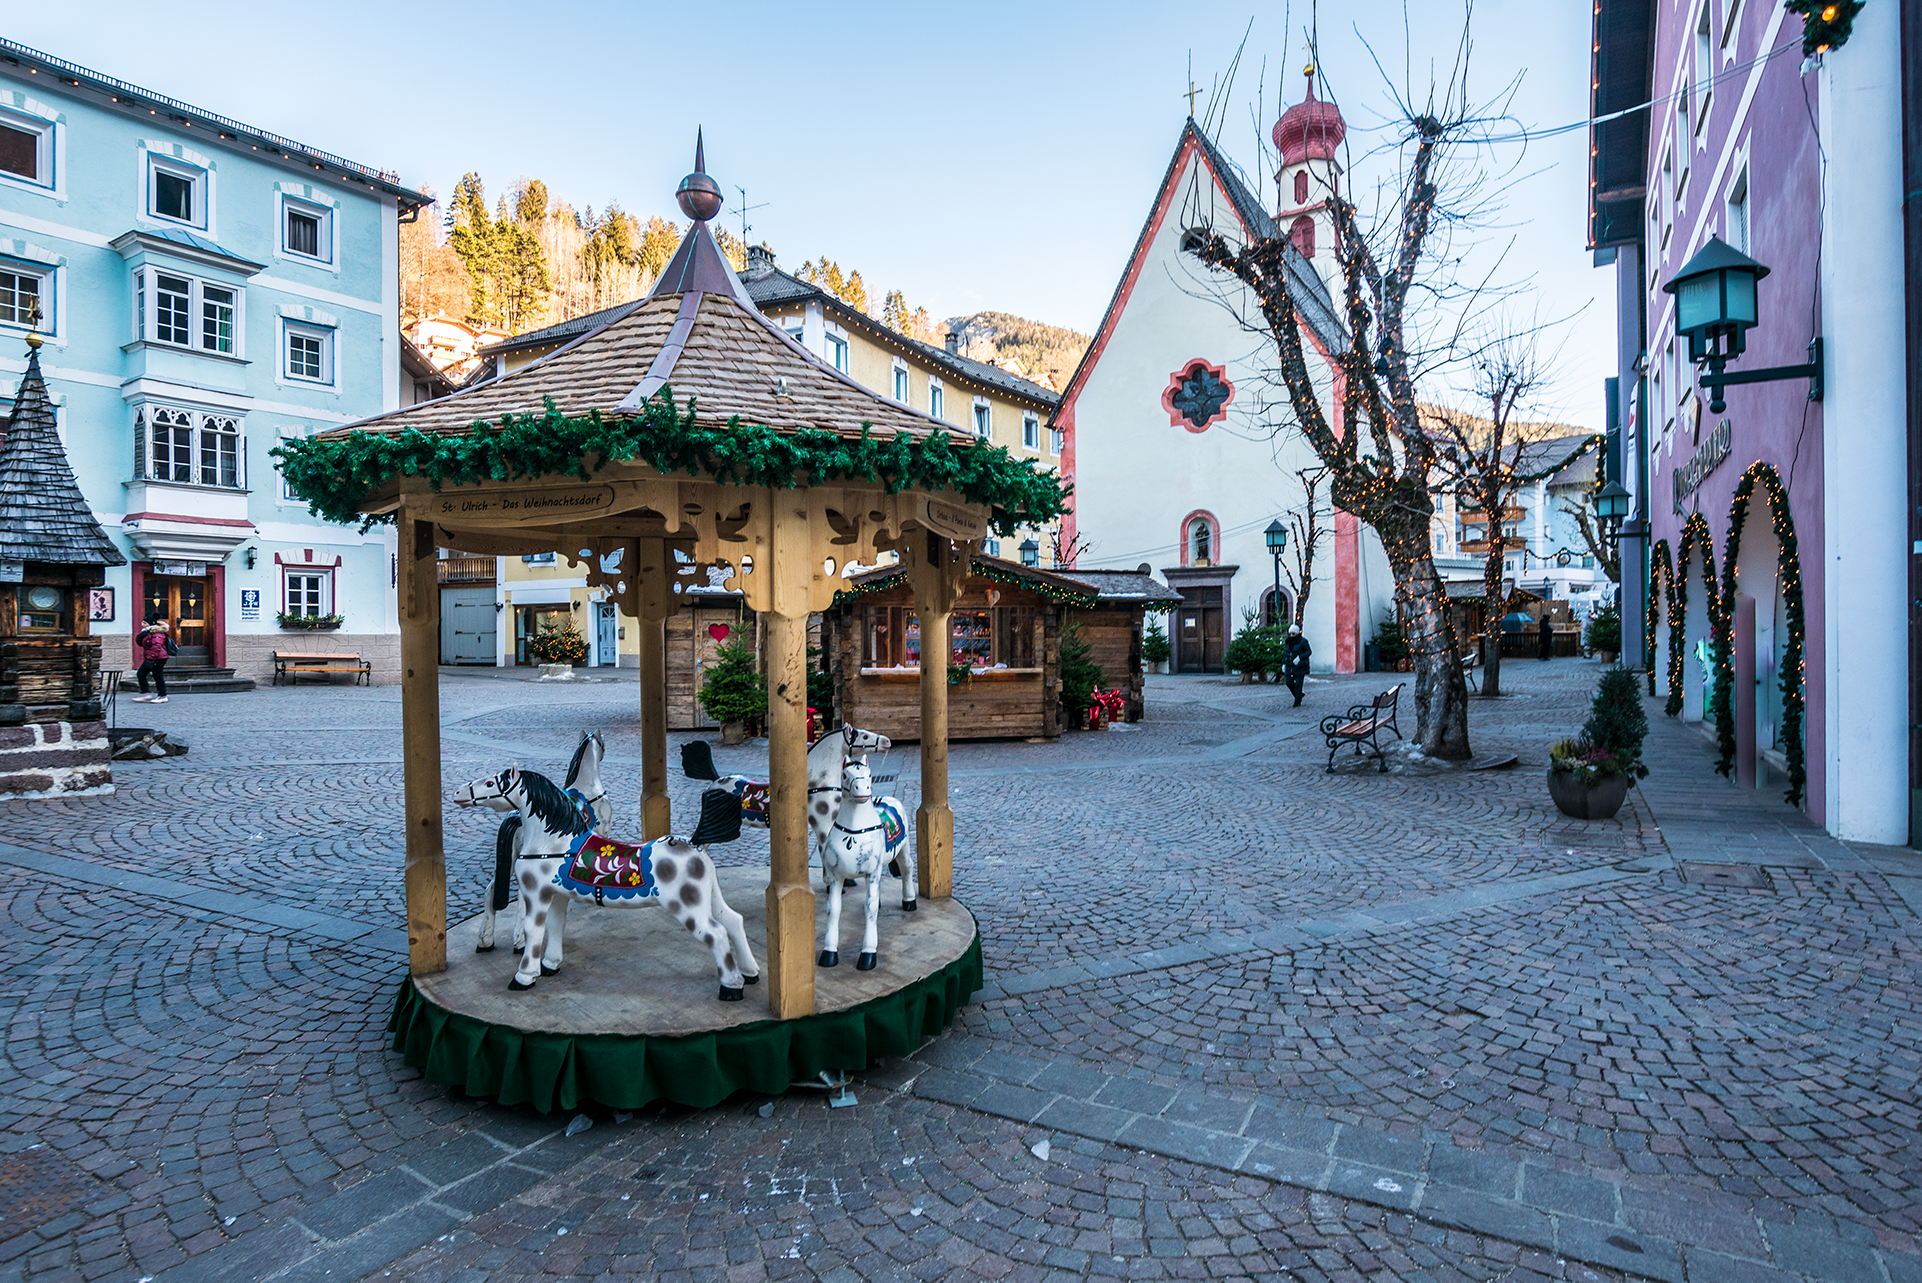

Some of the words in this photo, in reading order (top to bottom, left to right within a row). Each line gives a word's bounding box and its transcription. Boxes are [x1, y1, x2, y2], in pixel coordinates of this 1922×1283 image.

[441, 502, 456, 513] St.
[461, 500, 488, 511] Ulrich
[502, 499, 519, 509] Das
[524, 493, 603, 509] Weihnachtsdorf
